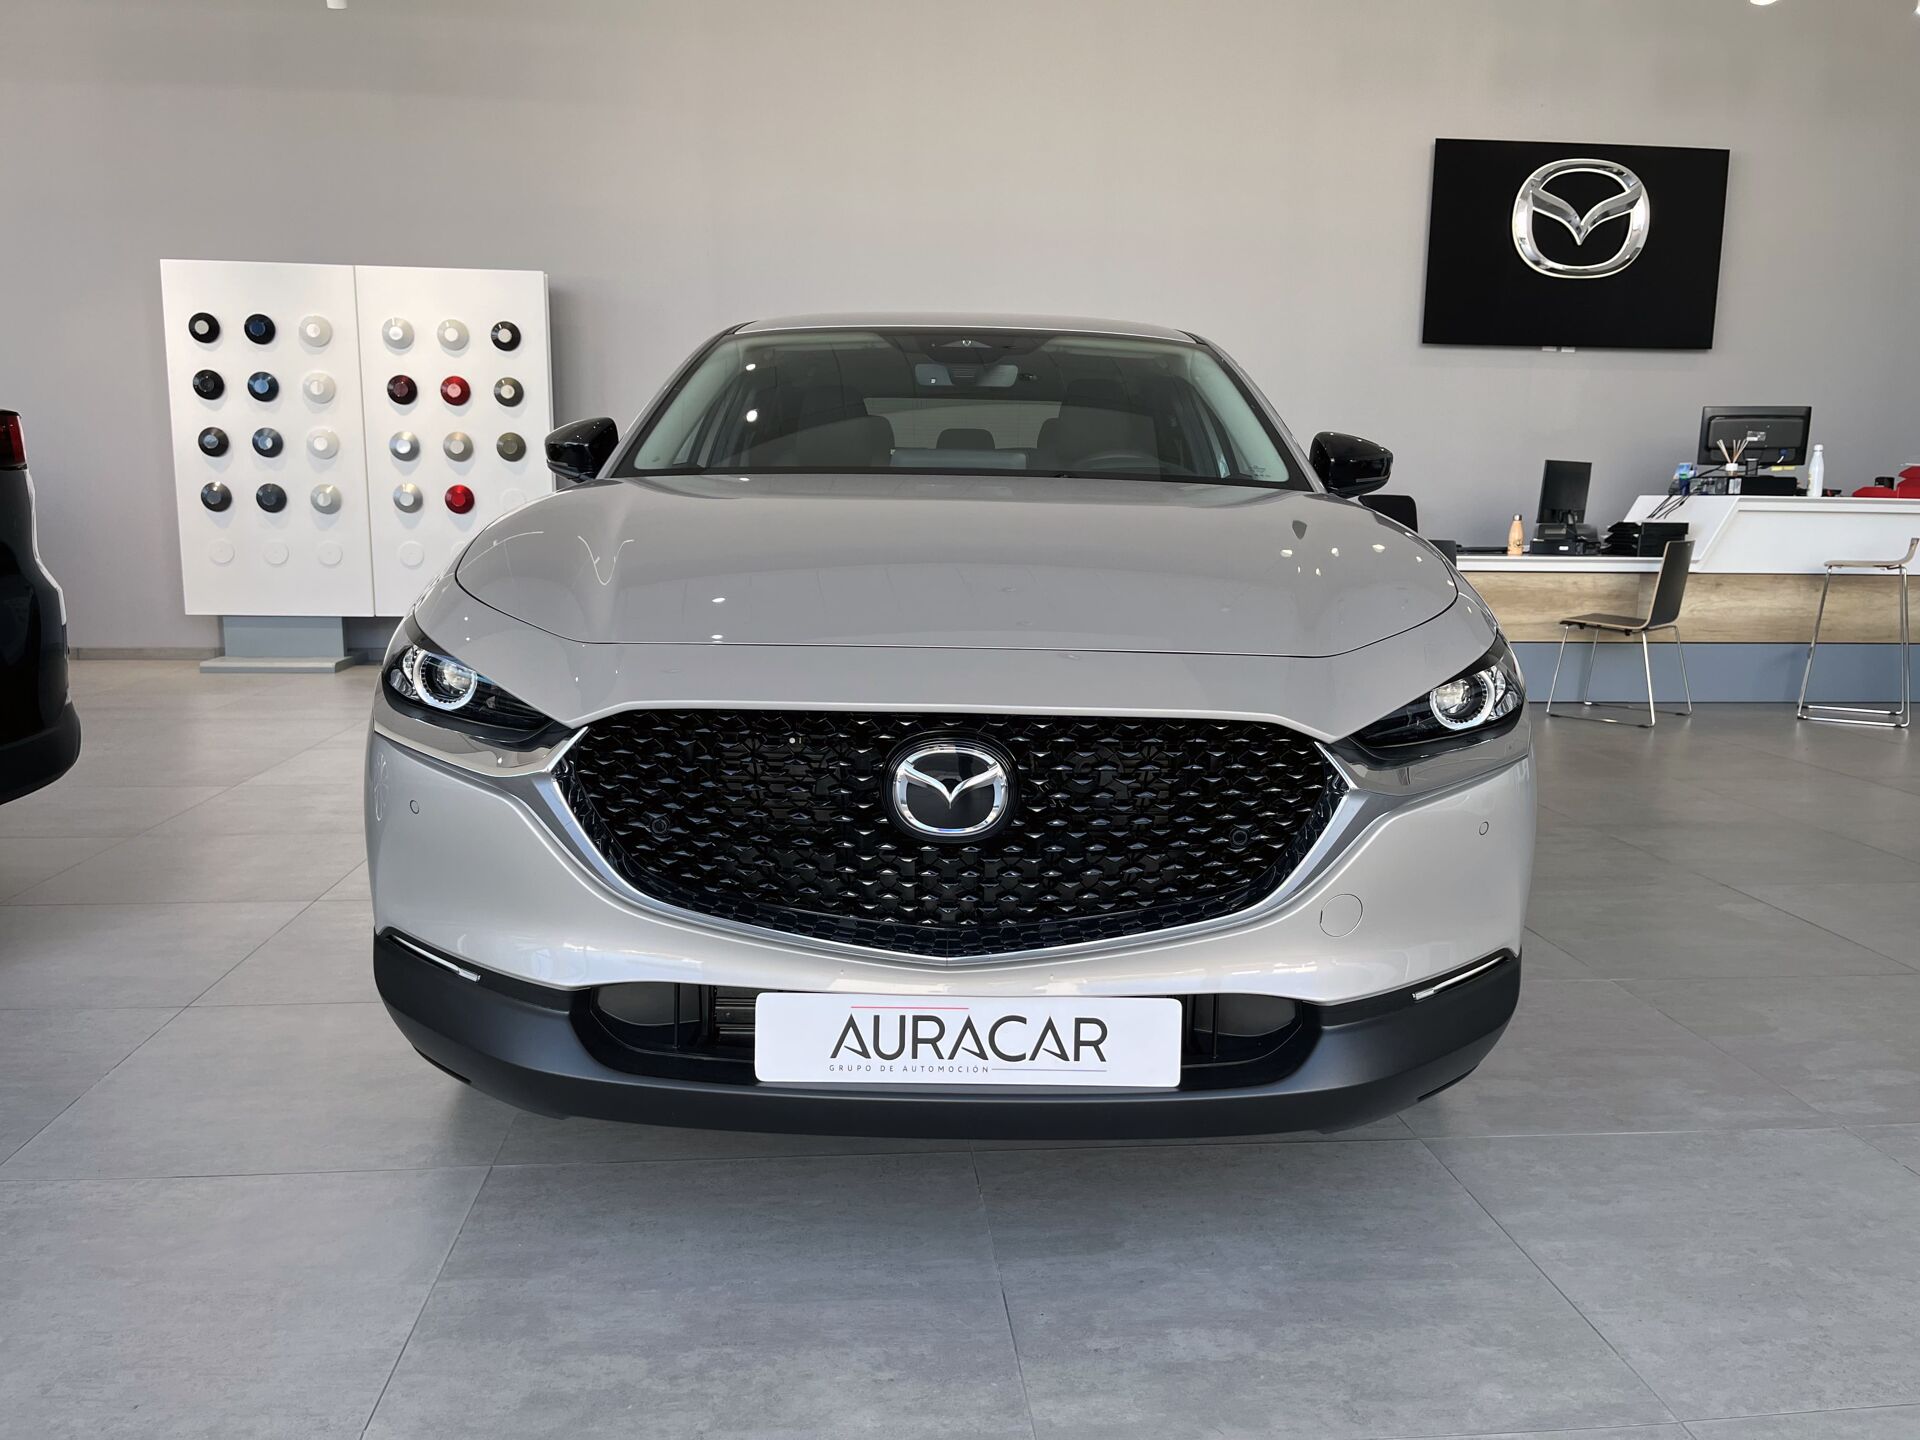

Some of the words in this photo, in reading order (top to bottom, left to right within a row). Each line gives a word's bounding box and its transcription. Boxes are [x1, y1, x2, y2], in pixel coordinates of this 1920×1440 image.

[829, 1013, 1108, 1062] AURACAR
[828, 1064, 872, 1072] GRUPO
[902, 1064, 989, 1073] AUTOMOCIÓN
